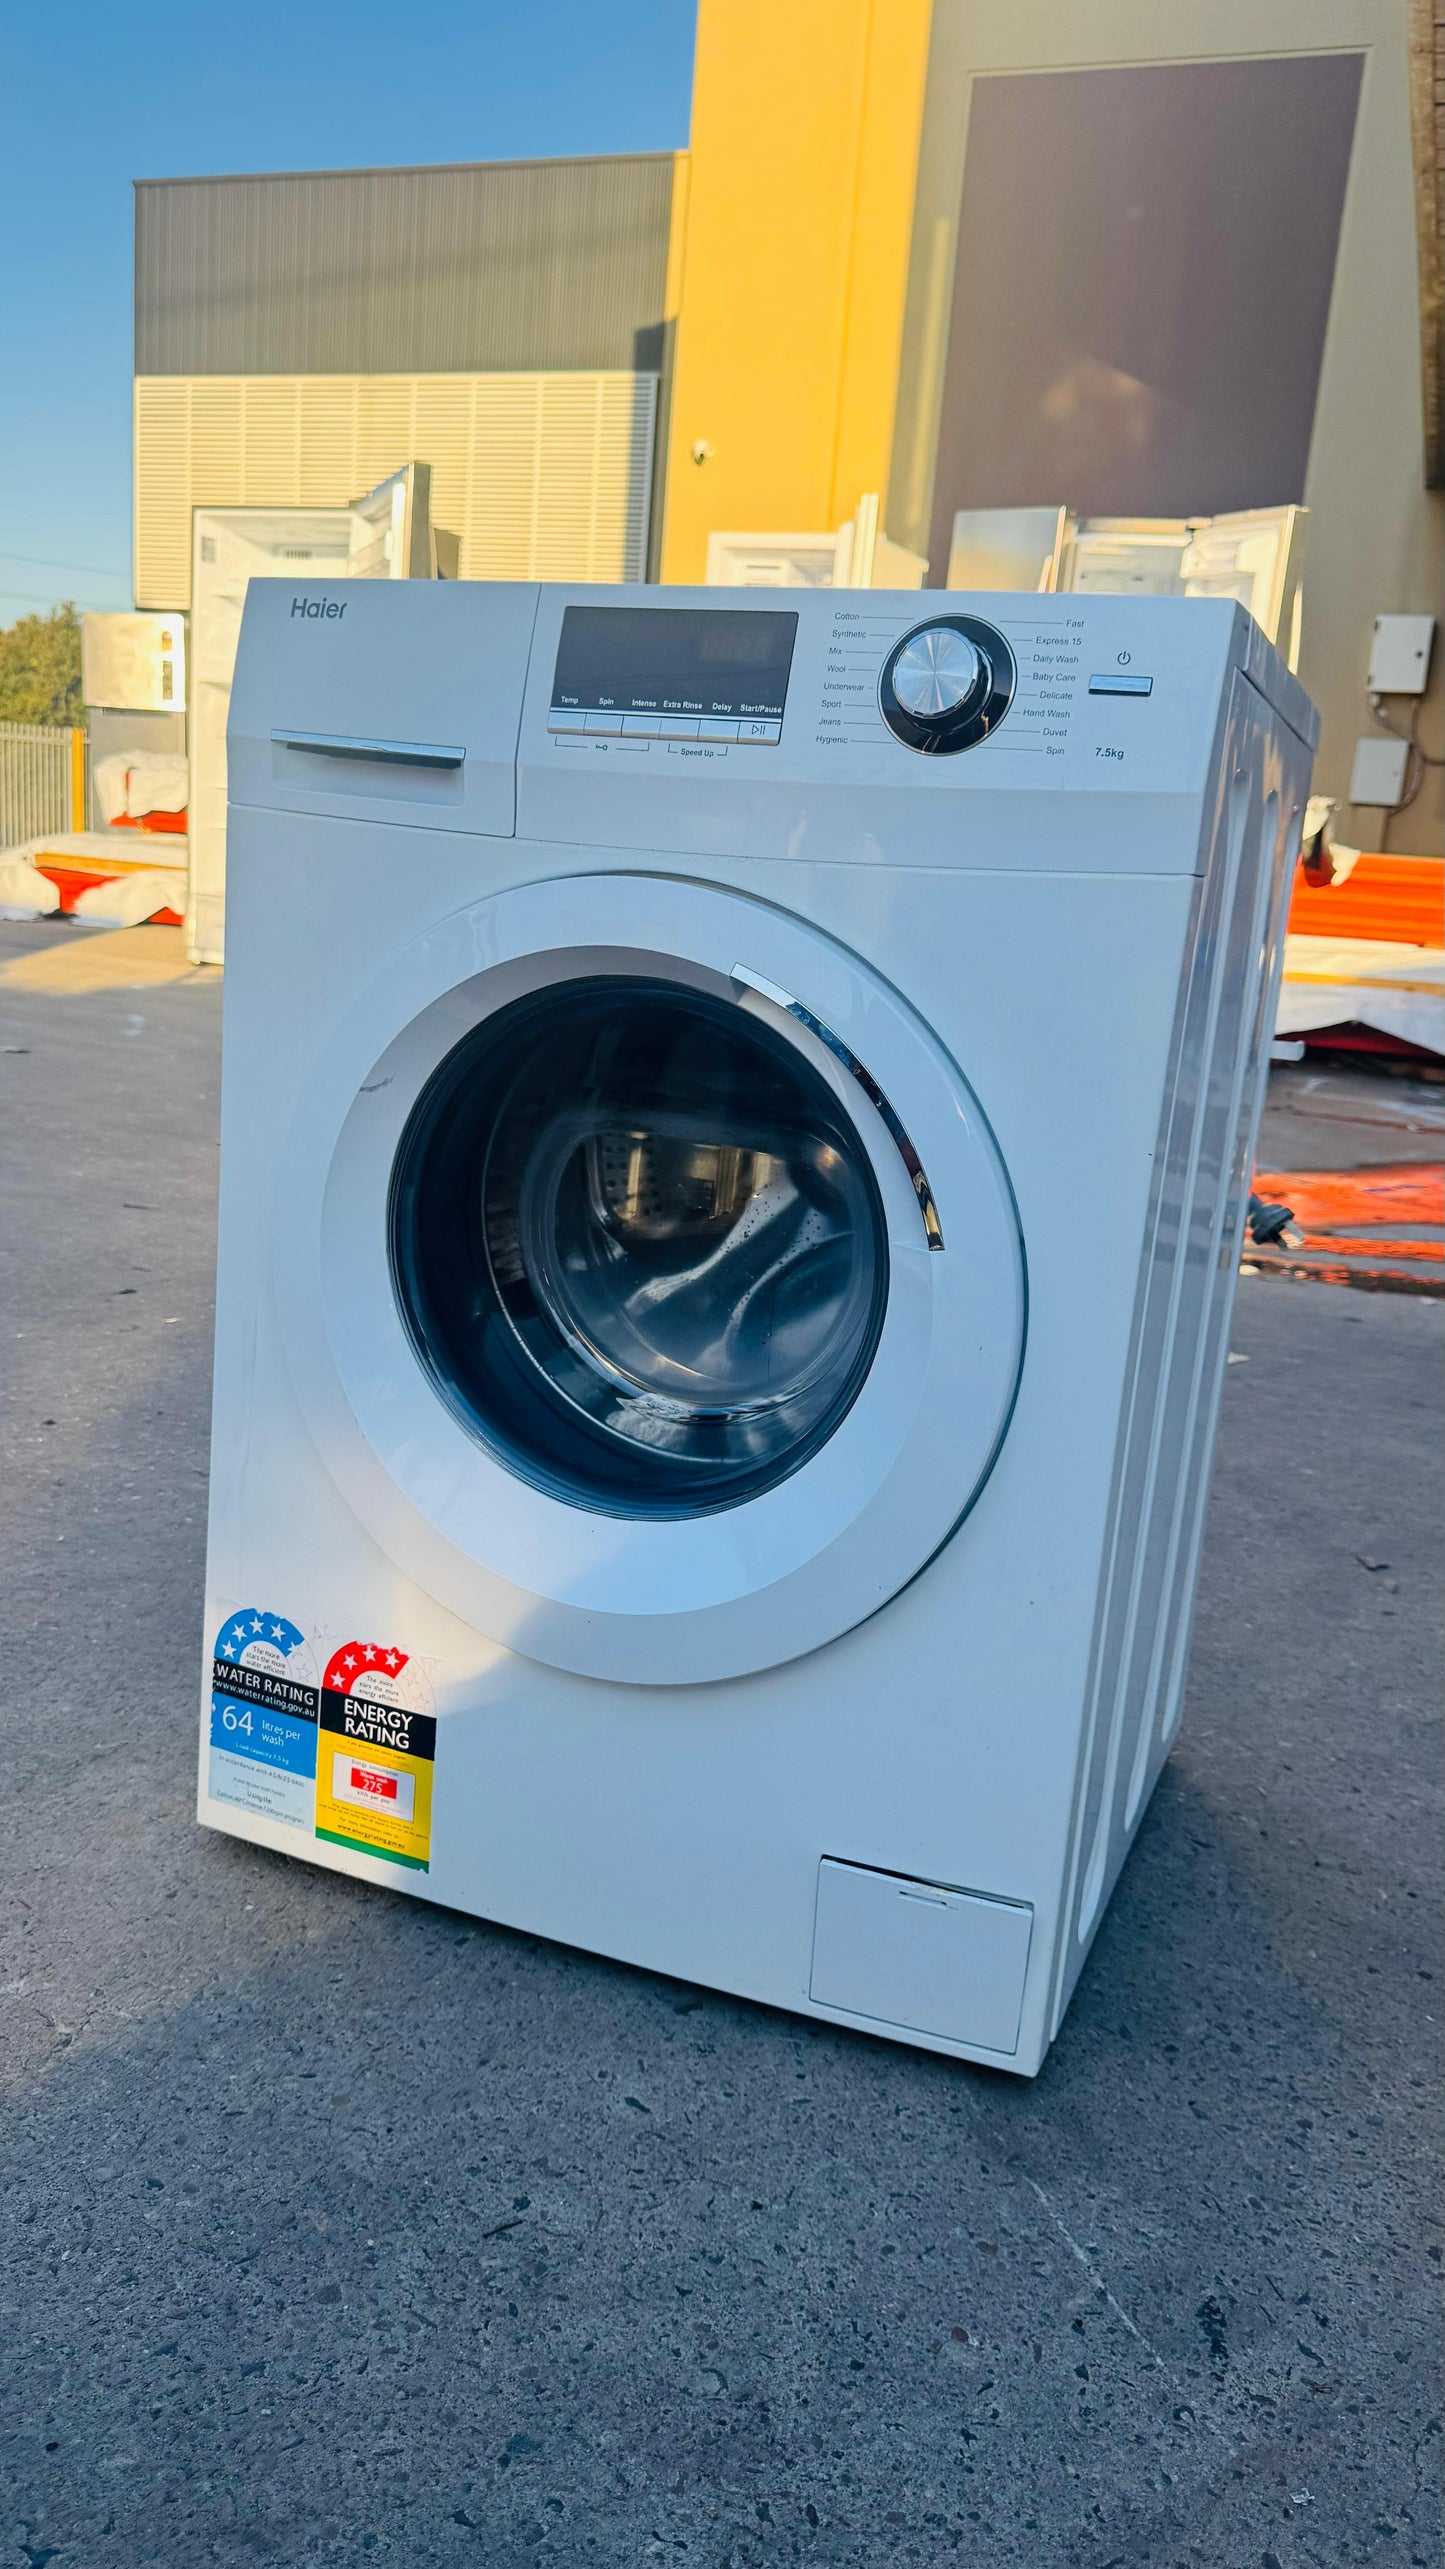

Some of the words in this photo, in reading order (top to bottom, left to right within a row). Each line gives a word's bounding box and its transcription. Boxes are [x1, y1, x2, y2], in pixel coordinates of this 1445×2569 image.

[290, 597, 348, 619] Haier
[834, 612, 860, 621] Cotton
[1065, 619, 1085, 628] Fast
[832, 629, 867, 639] Synthetic
[1035, 636, 1069, 646] Express
[1072, 638, 1082, 646] 15
[828, 647, 842, 655] Mix
[1032, 654, 1054, 664] Daily
[1055, 655, 1079, 664] Wash
[826, 665, 846, 673] Wool
[1032, 672, 1053, 683] Baby
[1055, 673, 1076, 682] Care
[823, 682, 865, 691] Underwear
[561, 696, 579, 705] Temp
[1039, 691, 1073, 700] Delicate
[598, 697, 615, 706] Spin
[632, 698, 657, 708] Intense
[663, 700, 681, 709] Extra
[682, 701, 703, 710] Rinse
[821, 700, 842, 709] Sport
[712, 702, 732, 713] Delay
[740, 703, 782, 714] Start/Pause
[1023, 708, 1045, 718] Hand
[1047, 709, 1071, 719] Wash
[818, 718, 842, 726] Jeans
[1042, 728, 1068, 737] Duvet
[816, 735, 848, 745] Hygienic
[681, 748, 703, 758] Speed
[704, 749, 715, 758] Up
[1046, 746, 1065, 756] Spin
[1095, 747, 1125, 760] 7.5kg
[252, 1645, 264, 1654] The
[264, 1650, 280, 1659] more
[271, 1660, 285, 1668] more
[216, 1663, 261, 1689] WATER
[265, 1679, 314, 1706] RATING
[379, 1679, 392, 1687] more
[358, 1688, 375, 1698] energy
[385, 1688, 398, 1696] more
[214, 1681, 315, 1718] www.waterrating.gov.au
[344, 1698, 413, 1731] ENERGY
[222, 1705, 254, 1736] 64
[262, 1720, 284, 1735] litres
[285, 1728, 301, 1740] per
[345, 1717, 410, 1750] RATING
[261, 1733, 284, 1747] wash
[351, 1758, 367, 1768] Energy
[362, 1778, 382, 1794] 275
[380, 1797, 390, 1805] year
